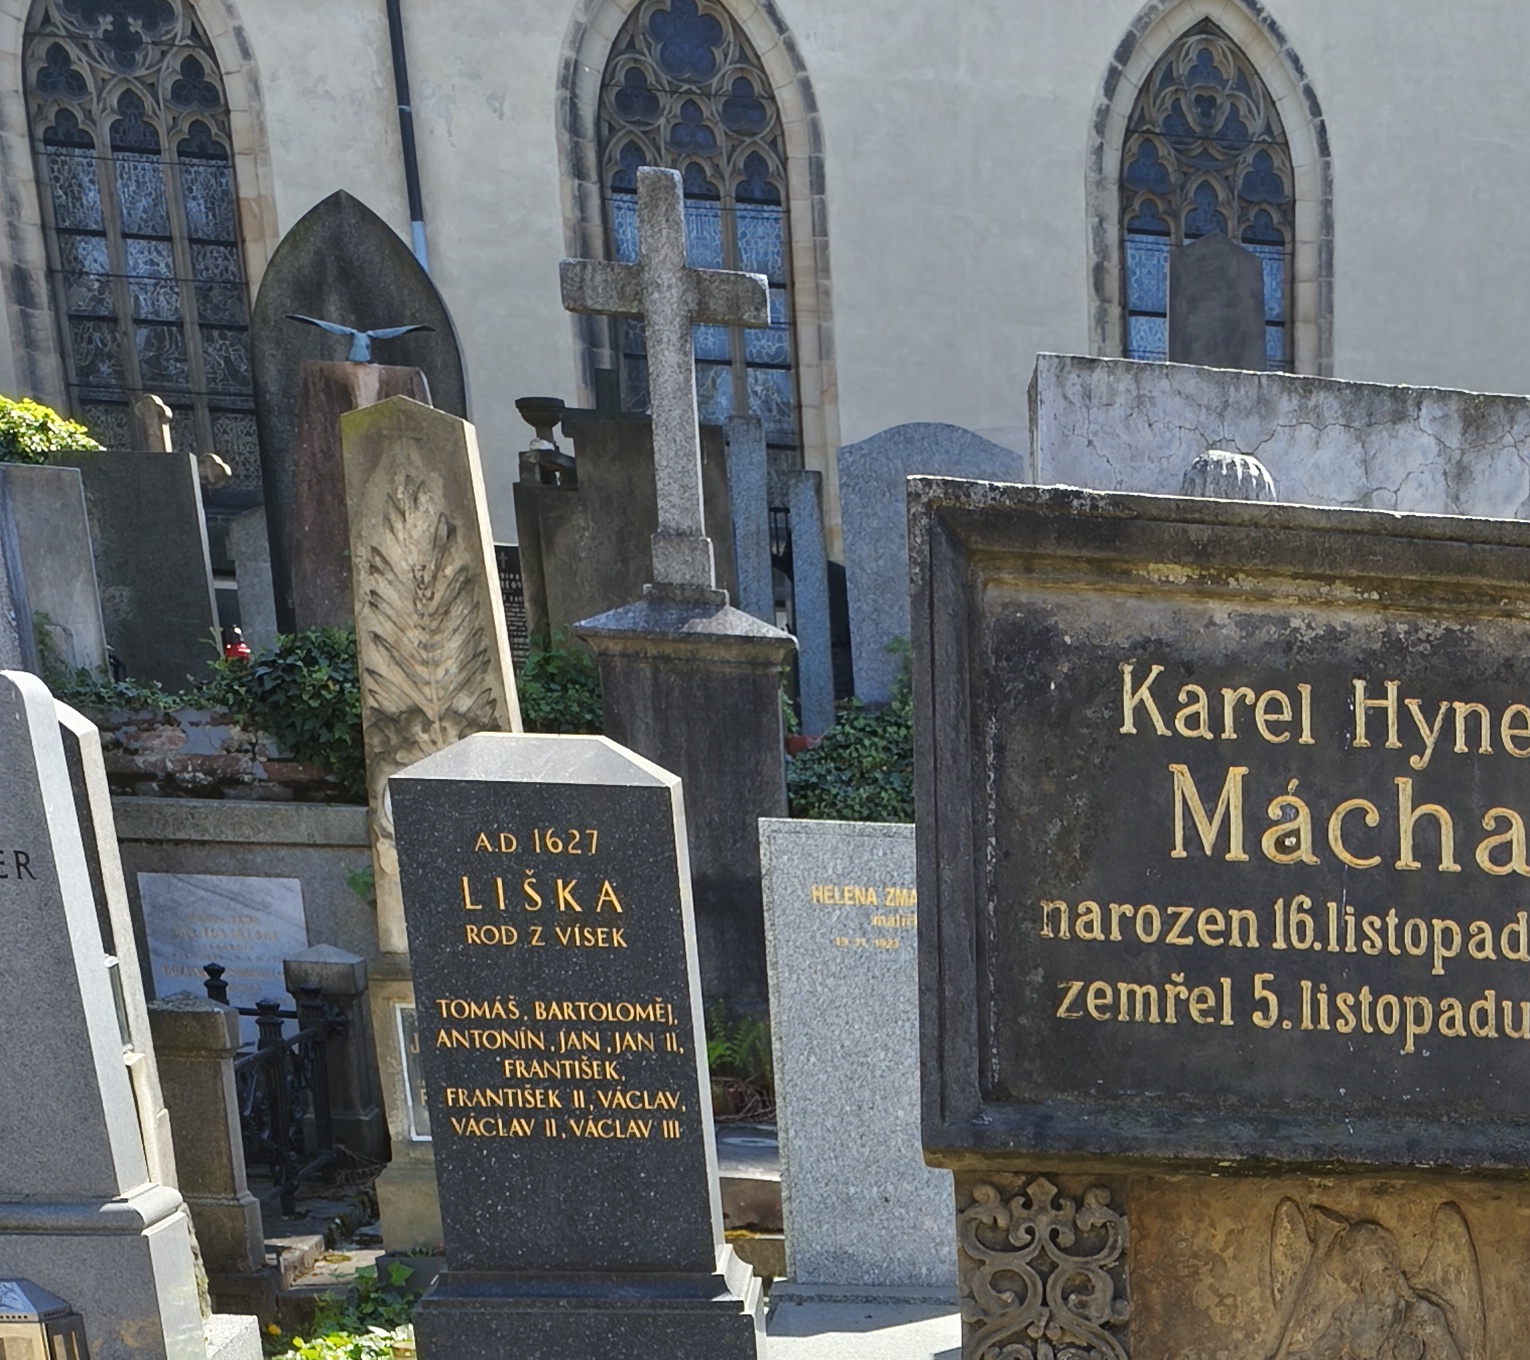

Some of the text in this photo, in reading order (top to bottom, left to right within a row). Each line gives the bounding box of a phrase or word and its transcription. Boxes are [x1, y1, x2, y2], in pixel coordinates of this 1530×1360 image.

[1118, 663, 1315, 744] Karel
[533, 828, 599, 854] 1627
[461, 869, 624, 913] LIŠKA
[811, 884, 878, 906] HELENA
[466, 923, 628, 948] ROD Z VÍSEK
[1040, 899, 1260, 948] narozen
[534, 998, 679, 1026] BARTOLOMĚJ,
[1056, 972, 1234, 1026] zemřel
[615, 1031, 655, 1053] JAN
[504, 1056, 626, 1081] FRANTIŠEK,
[446, 1084, 562, 1109] FRANTIŠEK
[597, 1086, 687, 1112] VÁCLAV,
[450, 1113, 535, 1137] VÁCLAV
[569, 1115, 652, 1138] VÁCLAV
